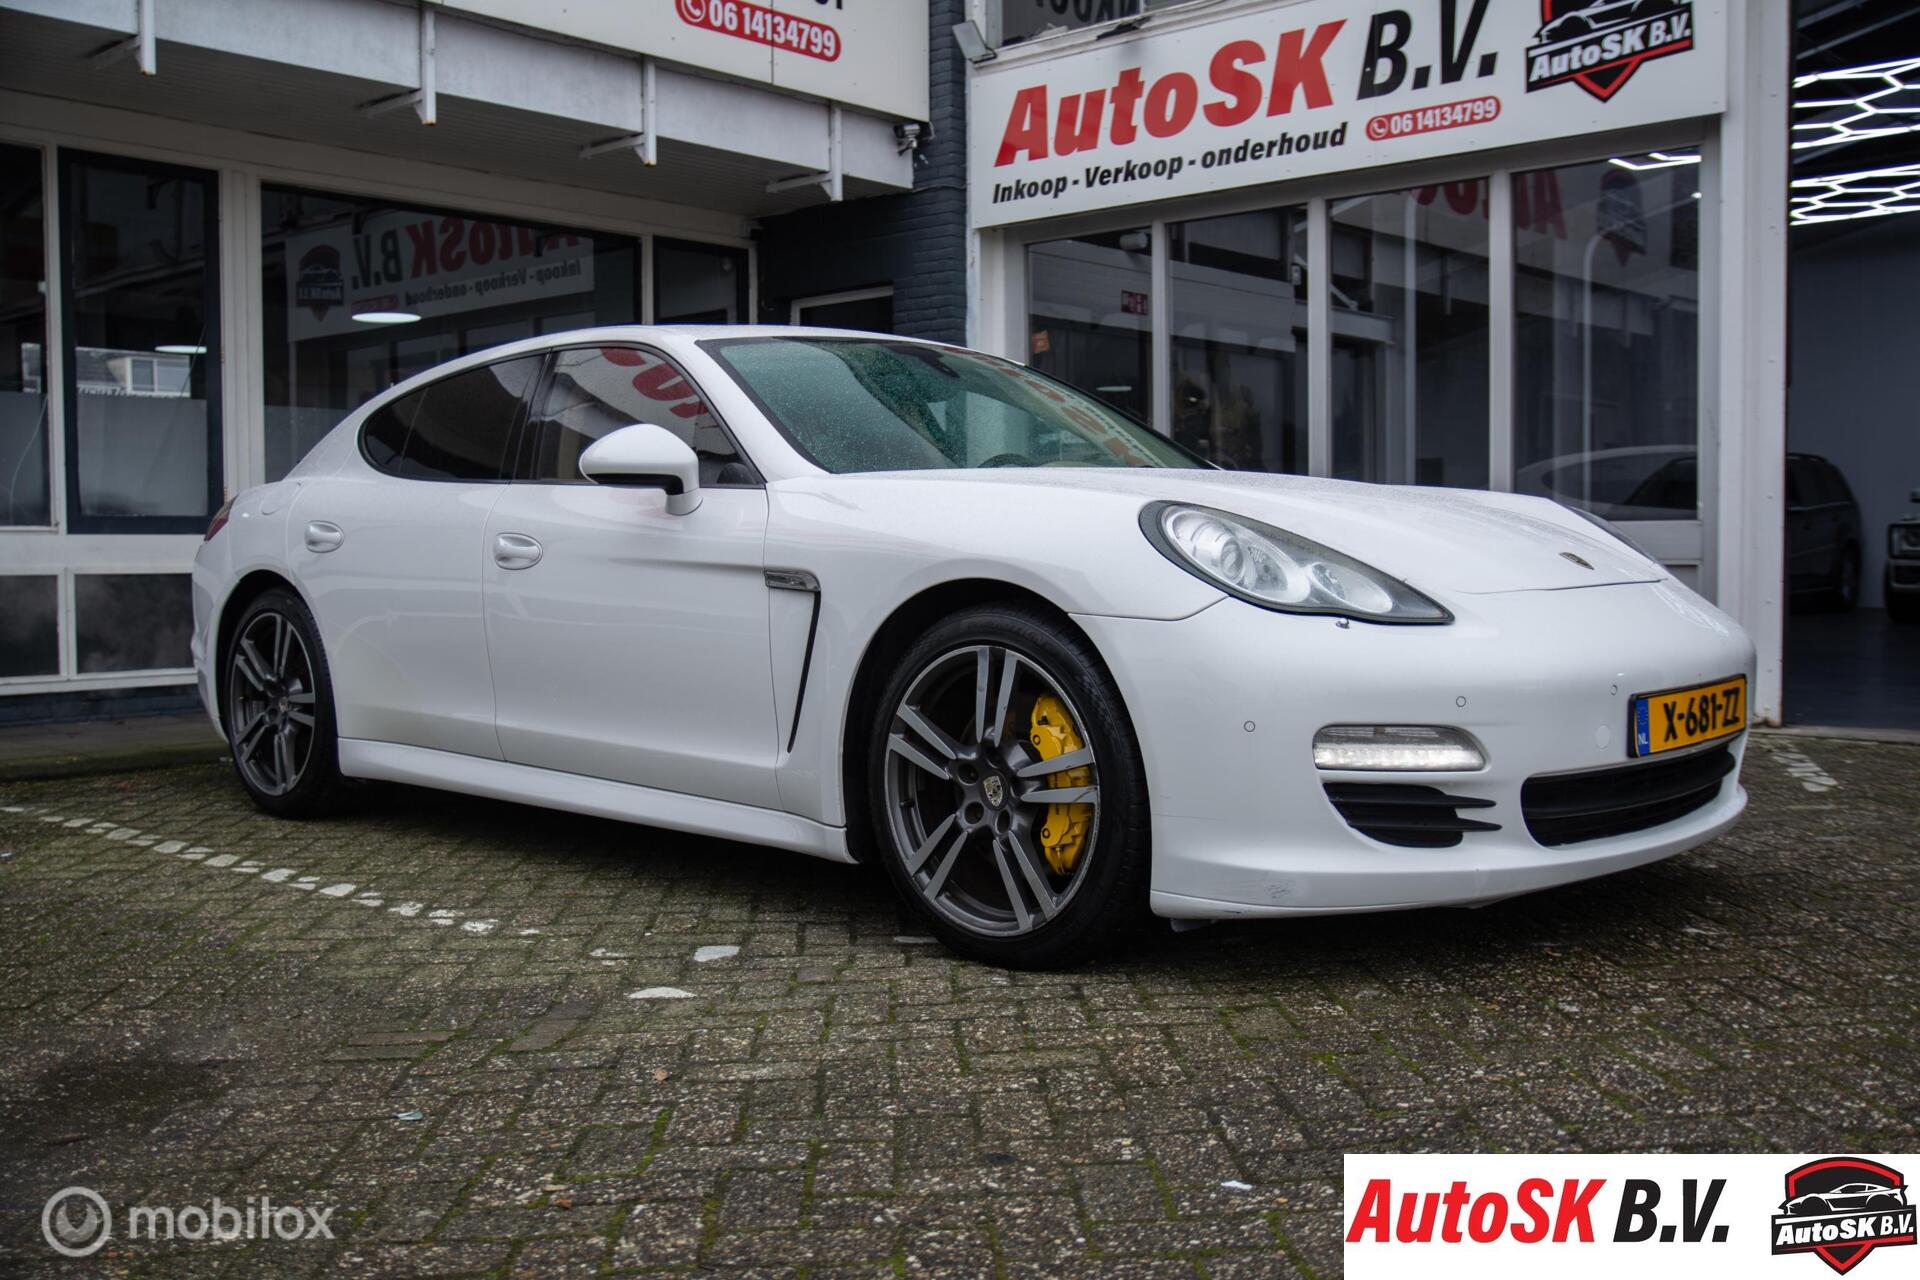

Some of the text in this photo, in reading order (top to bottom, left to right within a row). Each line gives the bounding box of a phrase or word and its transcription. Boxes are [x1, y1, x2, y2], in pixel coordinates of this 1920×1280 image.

[708, 0, 836, 58] 06 14134799
[1528, 12, 1692, 82] AutoSK B.V.
[993, 0, 1498, 168] AutoSK B.V.
[1389, 99, 1497, 133] 06 14134799
[992, 175, 1068, 204] Inkoop
[1084, 154, 1183, 188] Verkoop
[1201, 122, 1349, 169] onderhoud
[1638, 732, 1649, 745] NL
[1663, 687, 1740, 742] X-681-ZZ
